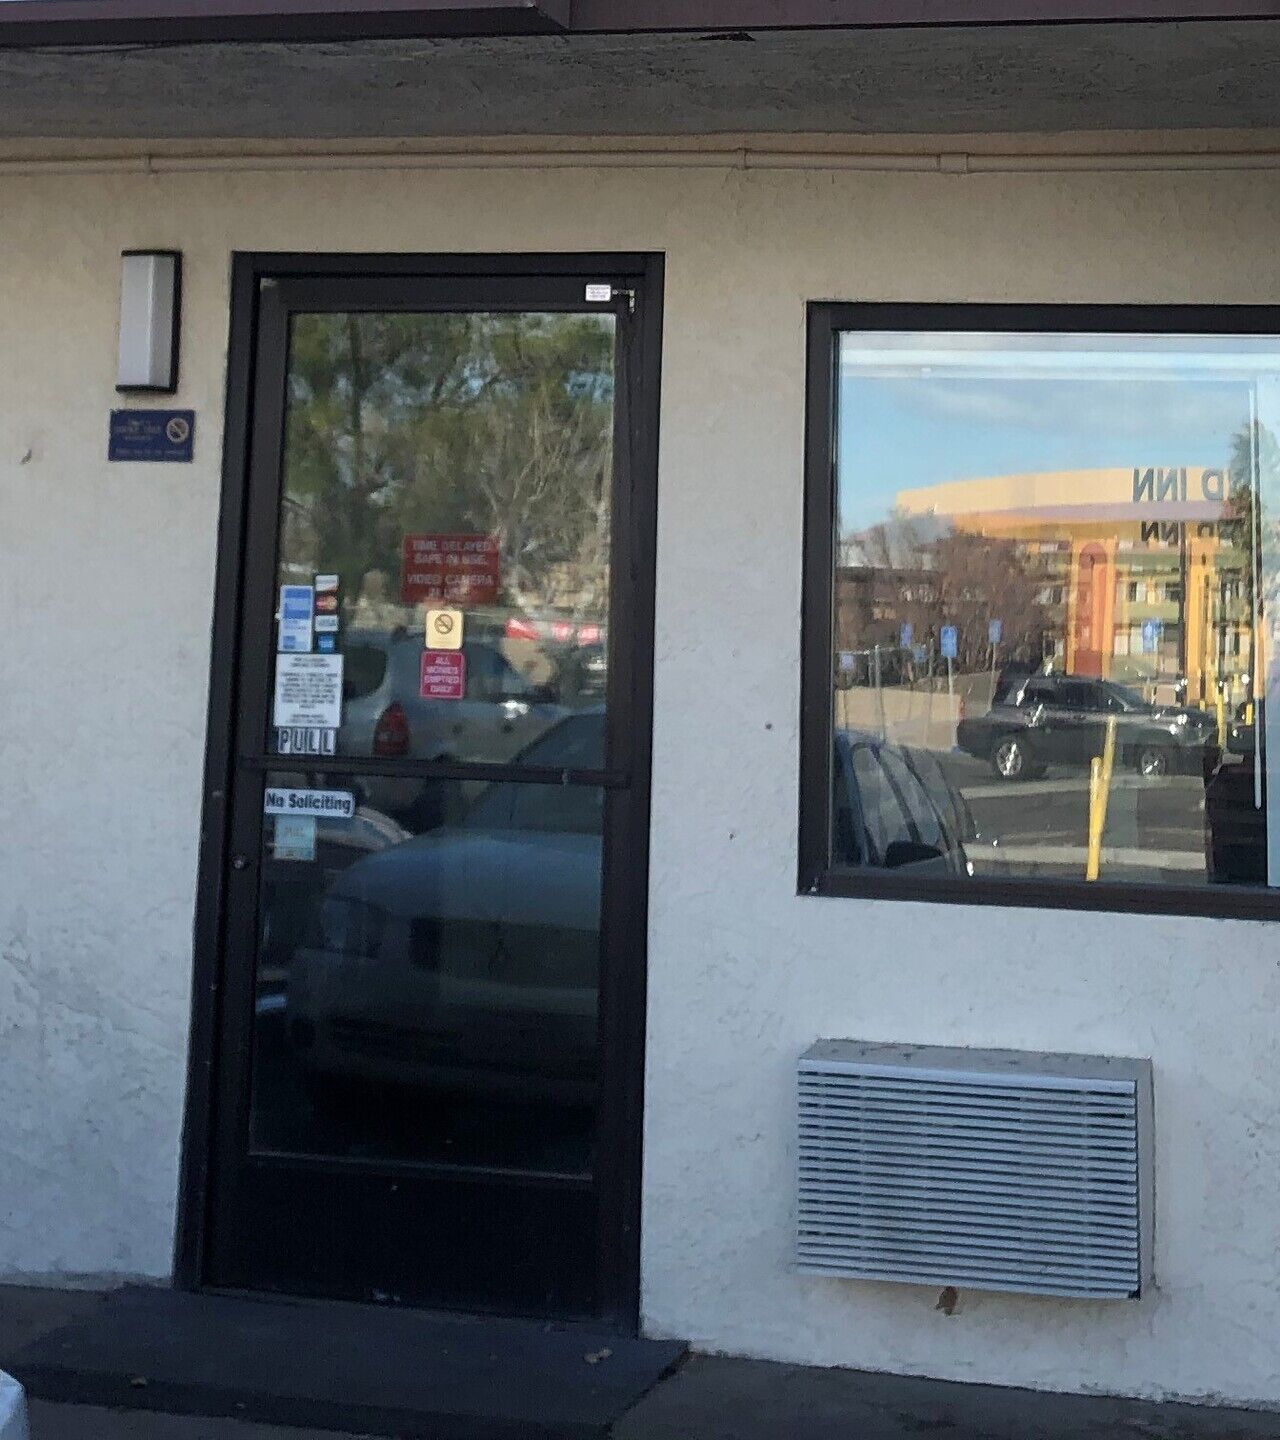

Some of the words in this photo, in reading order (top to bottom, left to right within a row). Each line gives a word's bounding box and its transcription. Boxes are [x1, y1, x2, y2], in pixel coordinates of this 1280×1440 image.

[280, 729, 332, 752] PULL
[265, 793, 284, 807] No
[288, 793, 351, 814] Soliciting
